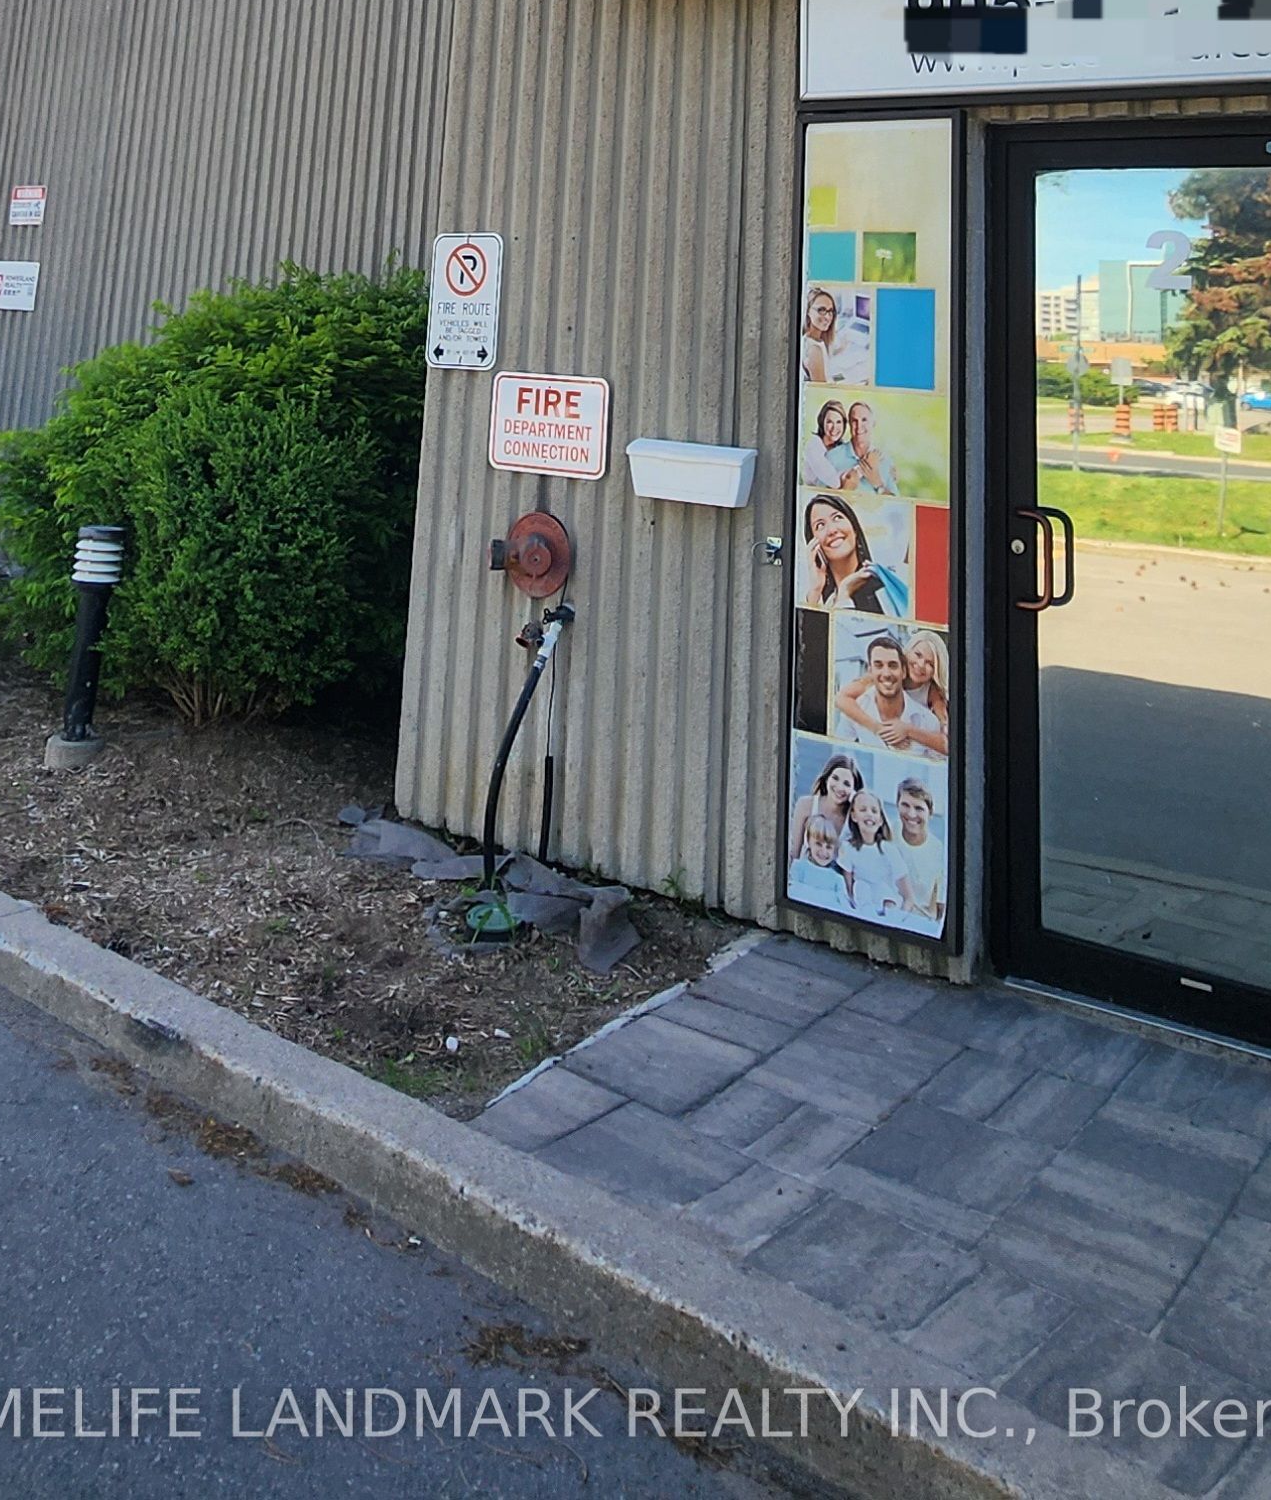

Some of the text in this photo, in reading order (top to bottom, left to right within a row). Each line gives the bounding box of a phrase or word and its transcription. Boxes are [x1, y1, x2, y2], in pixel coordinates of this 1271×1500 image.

[1145, 229, 1193, 291] 2
[437, 302, 491, 316] FIRE ROUTE
[516, 386, 582, 419] FIRE
[504, 418, 592, 442] DEPARTMENT
[503, 439, 590, 464] CONNECTION
